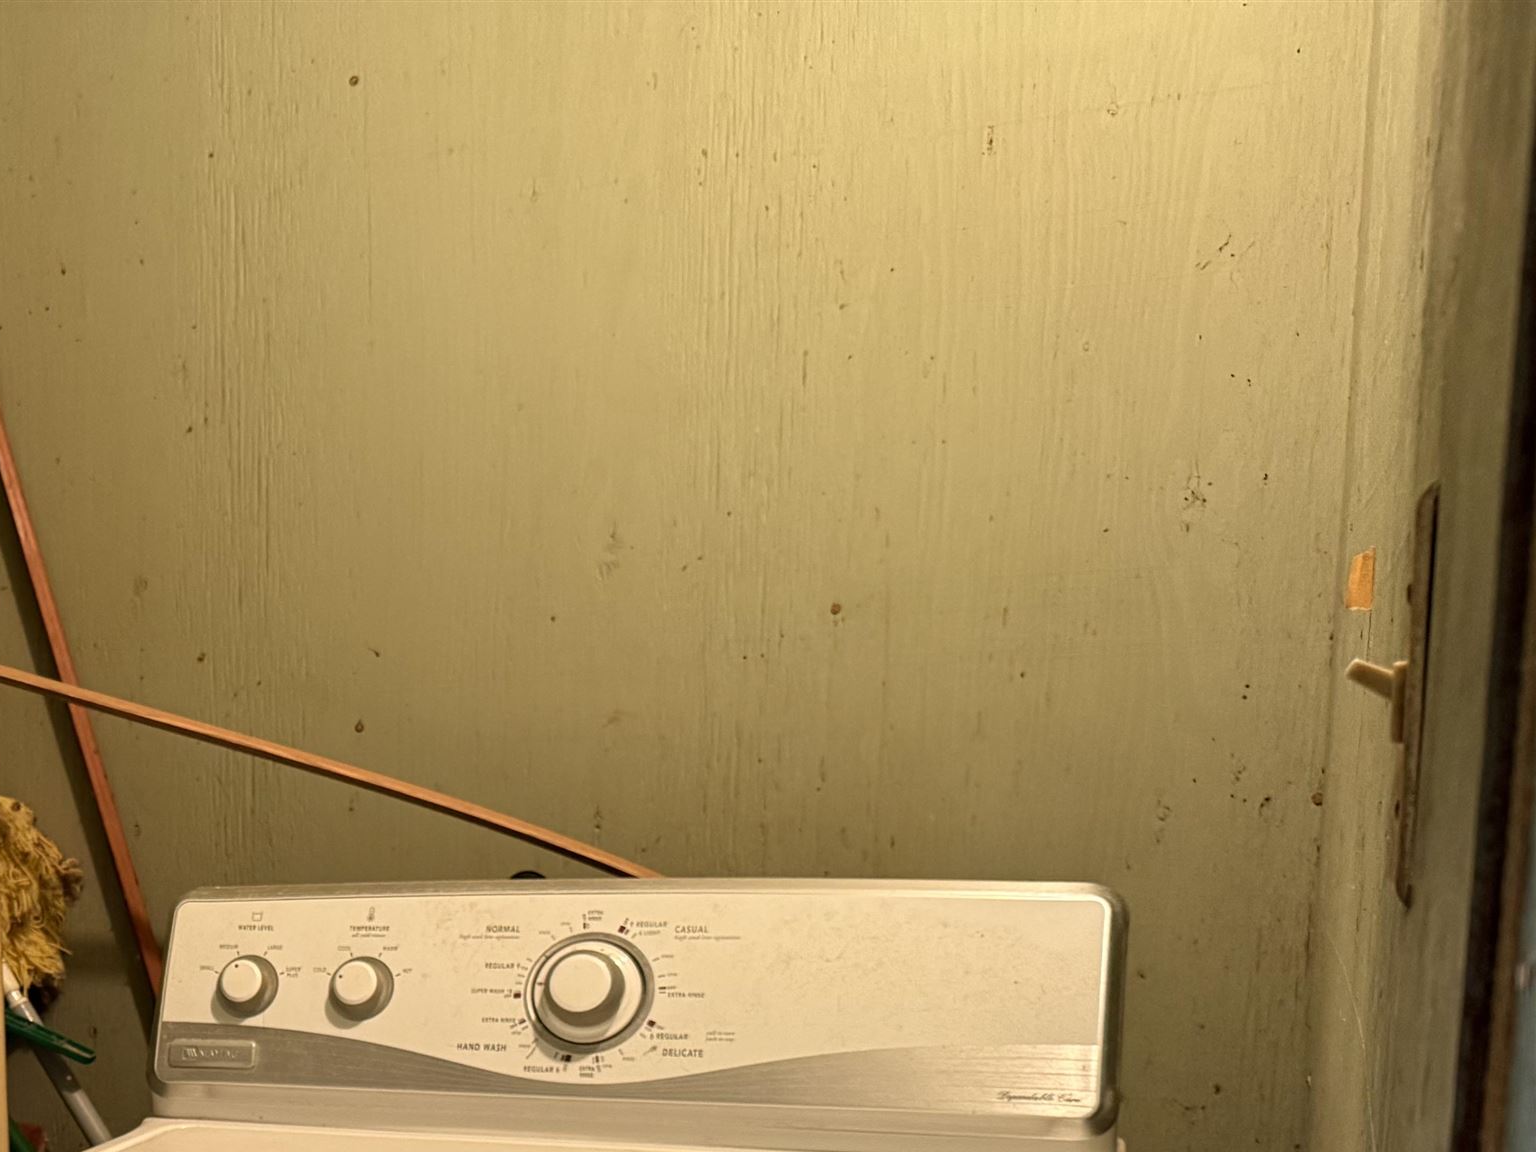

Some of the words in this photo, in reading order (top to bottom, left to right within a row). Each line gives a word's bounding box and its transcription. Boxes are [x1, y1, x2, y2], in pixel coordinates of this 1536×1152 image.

[238, 924, 256, 932] WATER
[258, 924, 274, 932] LEVEL
[350, 924, 390, 932] TEMPERATURE
[486, 924, 521, 933] NORMAL
[636, 920, 668, 929] REGULAR
[674, 925, 709, 934] CASUAL
[485, 962, 515, 970] REGULAR
[656, 1032, 689, 1040] REGULAR
[457, 1043, 481, 1051] HAND
[483, 1043, 507, 1052] WASH
[662, 1048, 704, 1058] DELICATE
[524, 1065, 554, 1073] REGULAR
